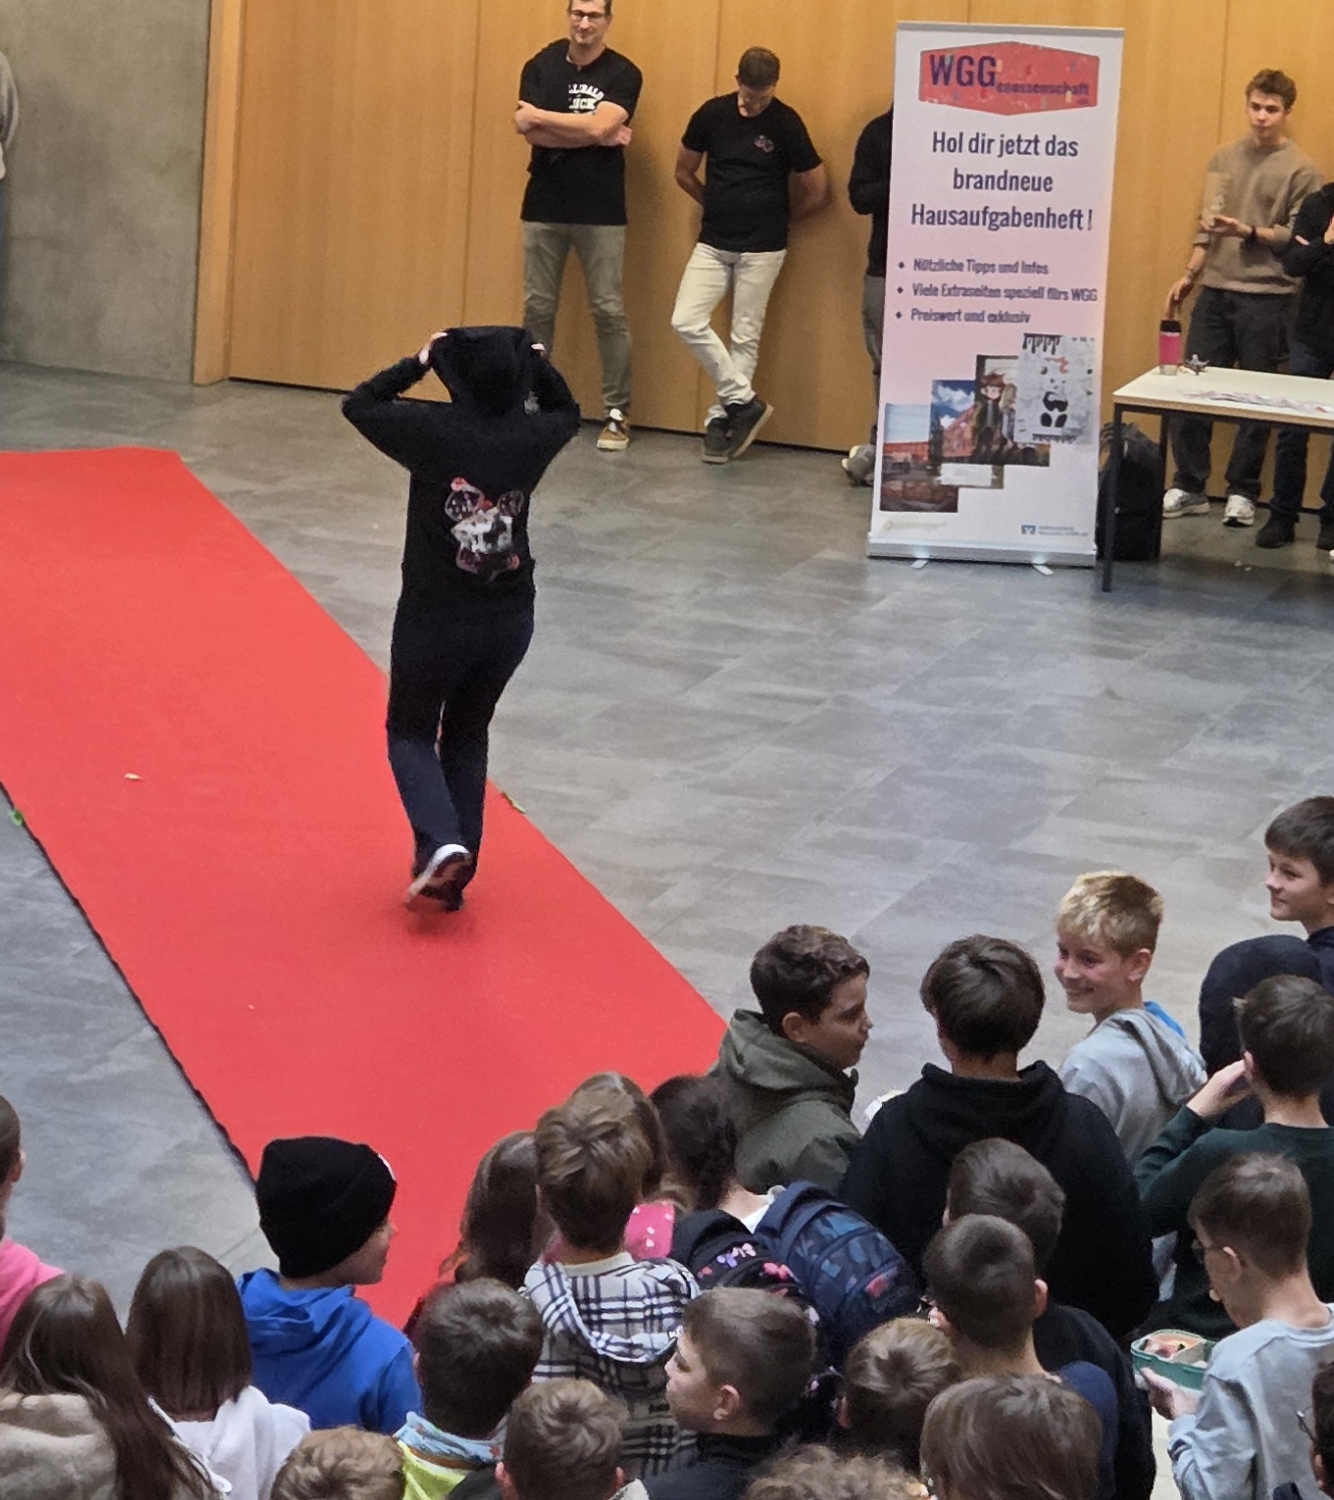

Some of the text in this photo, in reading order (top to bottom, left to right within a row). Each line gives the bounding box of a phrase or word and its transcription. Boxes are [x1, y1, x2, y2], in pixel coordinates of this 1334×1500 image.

[932, 131, 1079, 158] Hol dir jetzt das
[953, 168, 1054, 193] brandneue
[911, 203, 1083, 231] Hausaufgabenheft
[966, 259, 995, 276] Tipps
[998, 261, 1019, 273] und
[1021, 261, 1049, 275] Infos
[913, 283, 1098, 302] Viele Extraseiten speziell fürs WGG
[911, 308, 1031, 324] Preiswert und exklusiv
